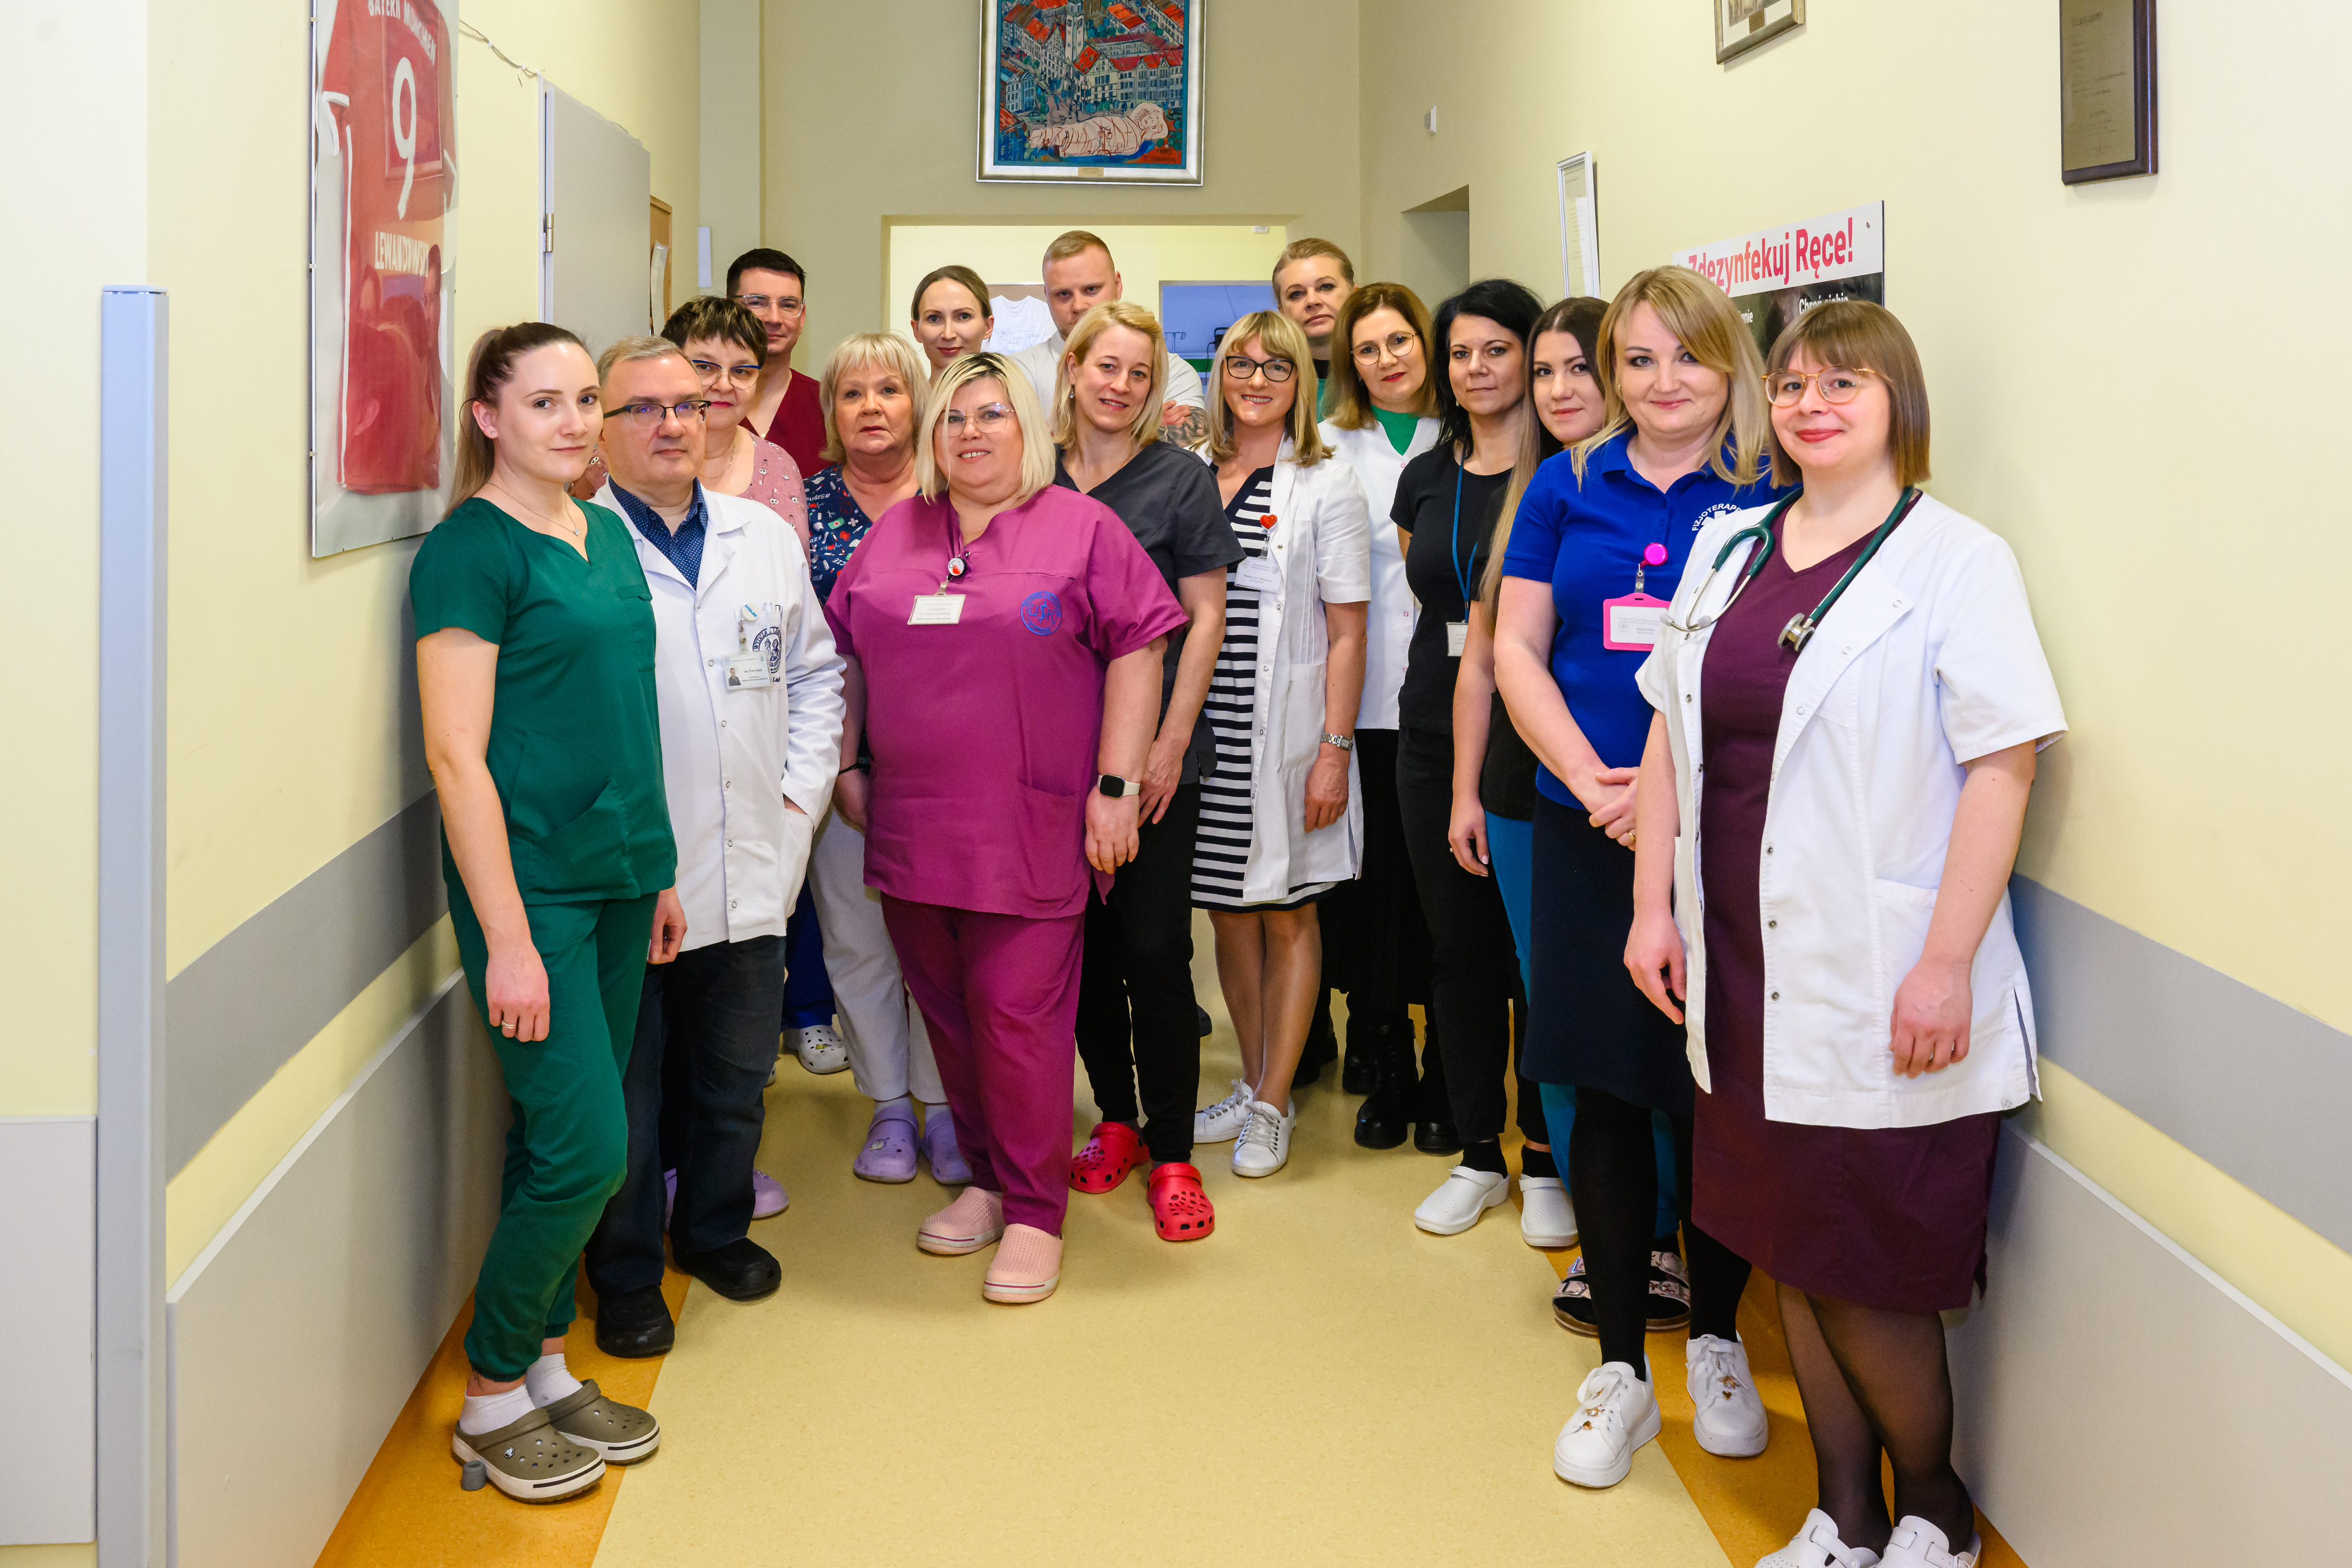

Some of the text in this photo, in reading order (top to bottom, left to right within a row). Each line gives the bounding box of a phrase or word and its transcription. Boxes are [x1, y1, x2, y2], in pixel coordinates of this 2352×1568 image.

[368, 0, 400, 19] BAYERN
[392, 57, 417, 220] 9
[1689, 217, 1853, 295] Zdezynfekuj Ręce!
[745, 604, 757, 617] ECOLAB
